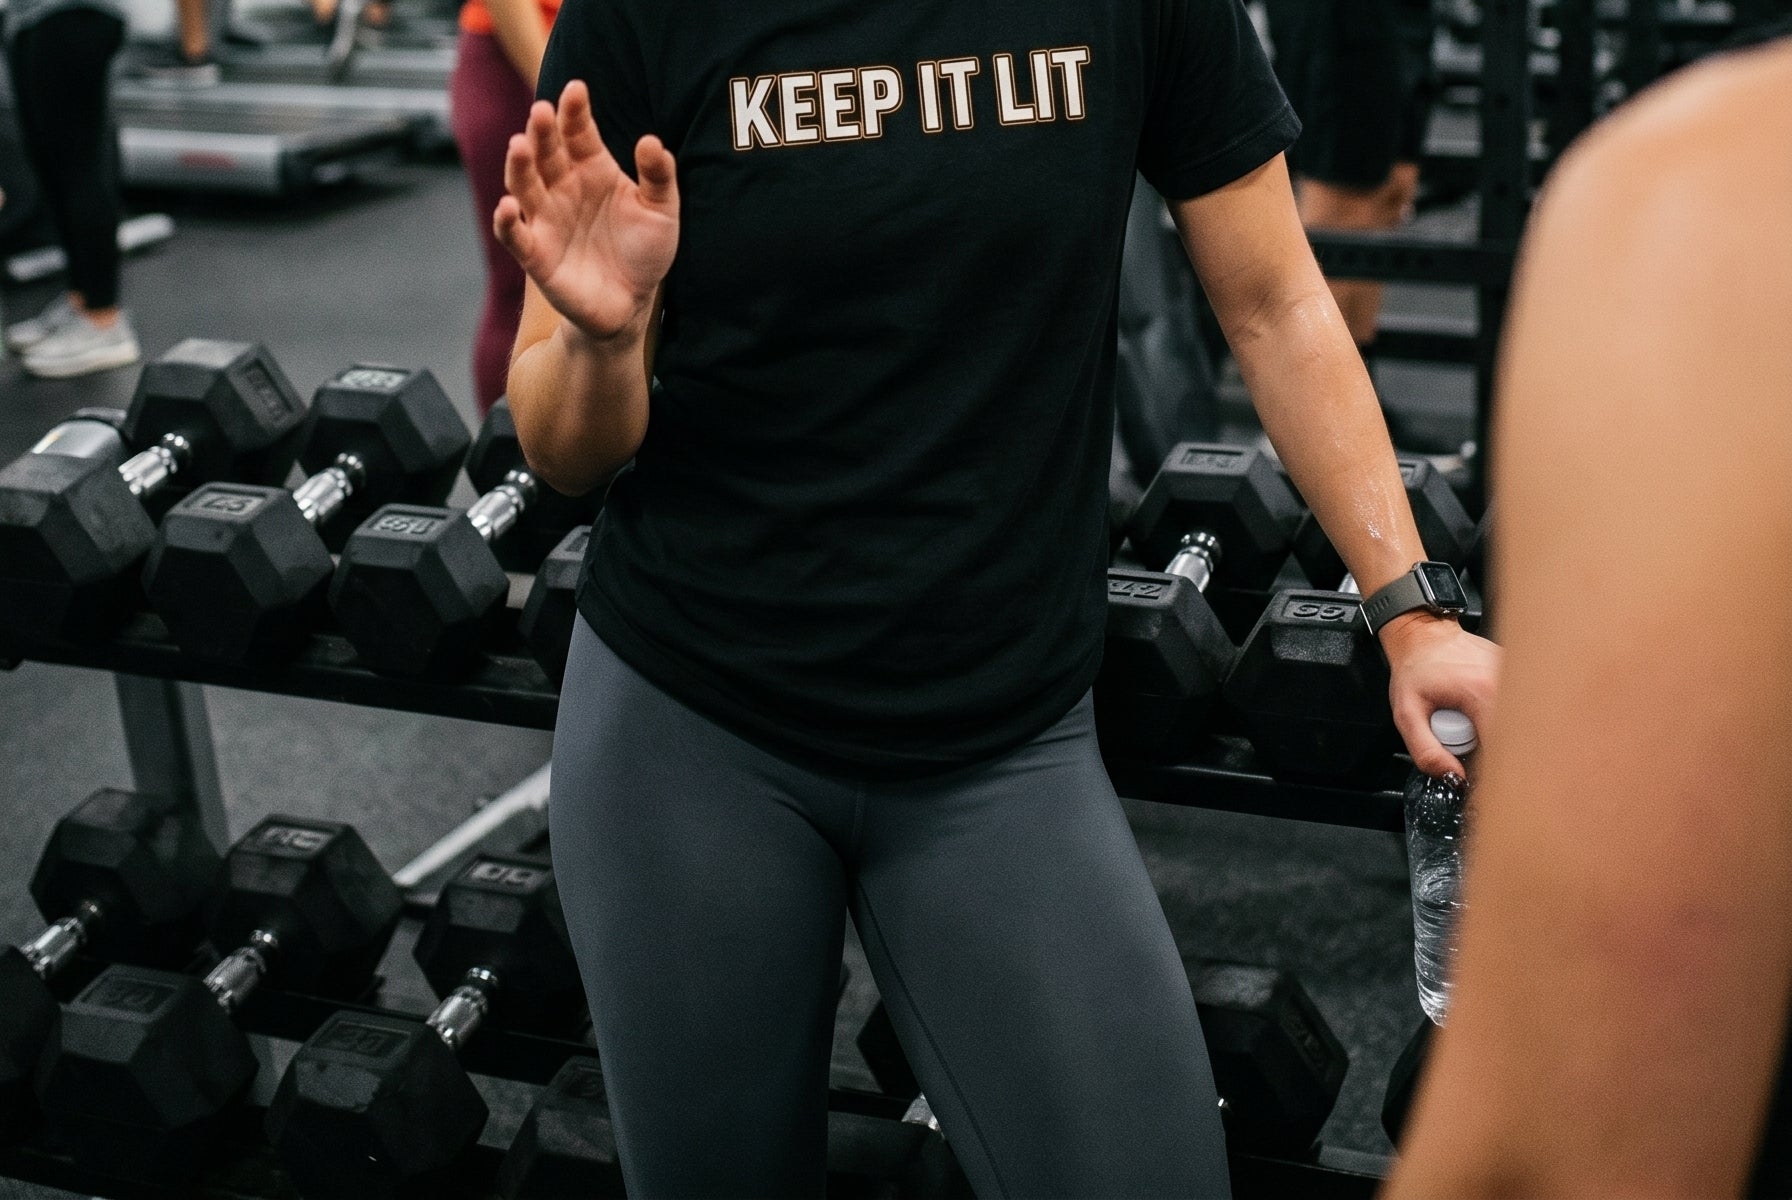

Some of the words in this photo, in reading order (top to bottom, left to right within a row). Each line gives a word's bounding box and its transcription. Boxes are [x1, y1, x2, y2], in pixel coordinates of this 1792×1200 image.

[729, 65, 904, 151] KEEP
[917, 56, 980, 133] IT
[993, 45, 1091, 126] LIT
